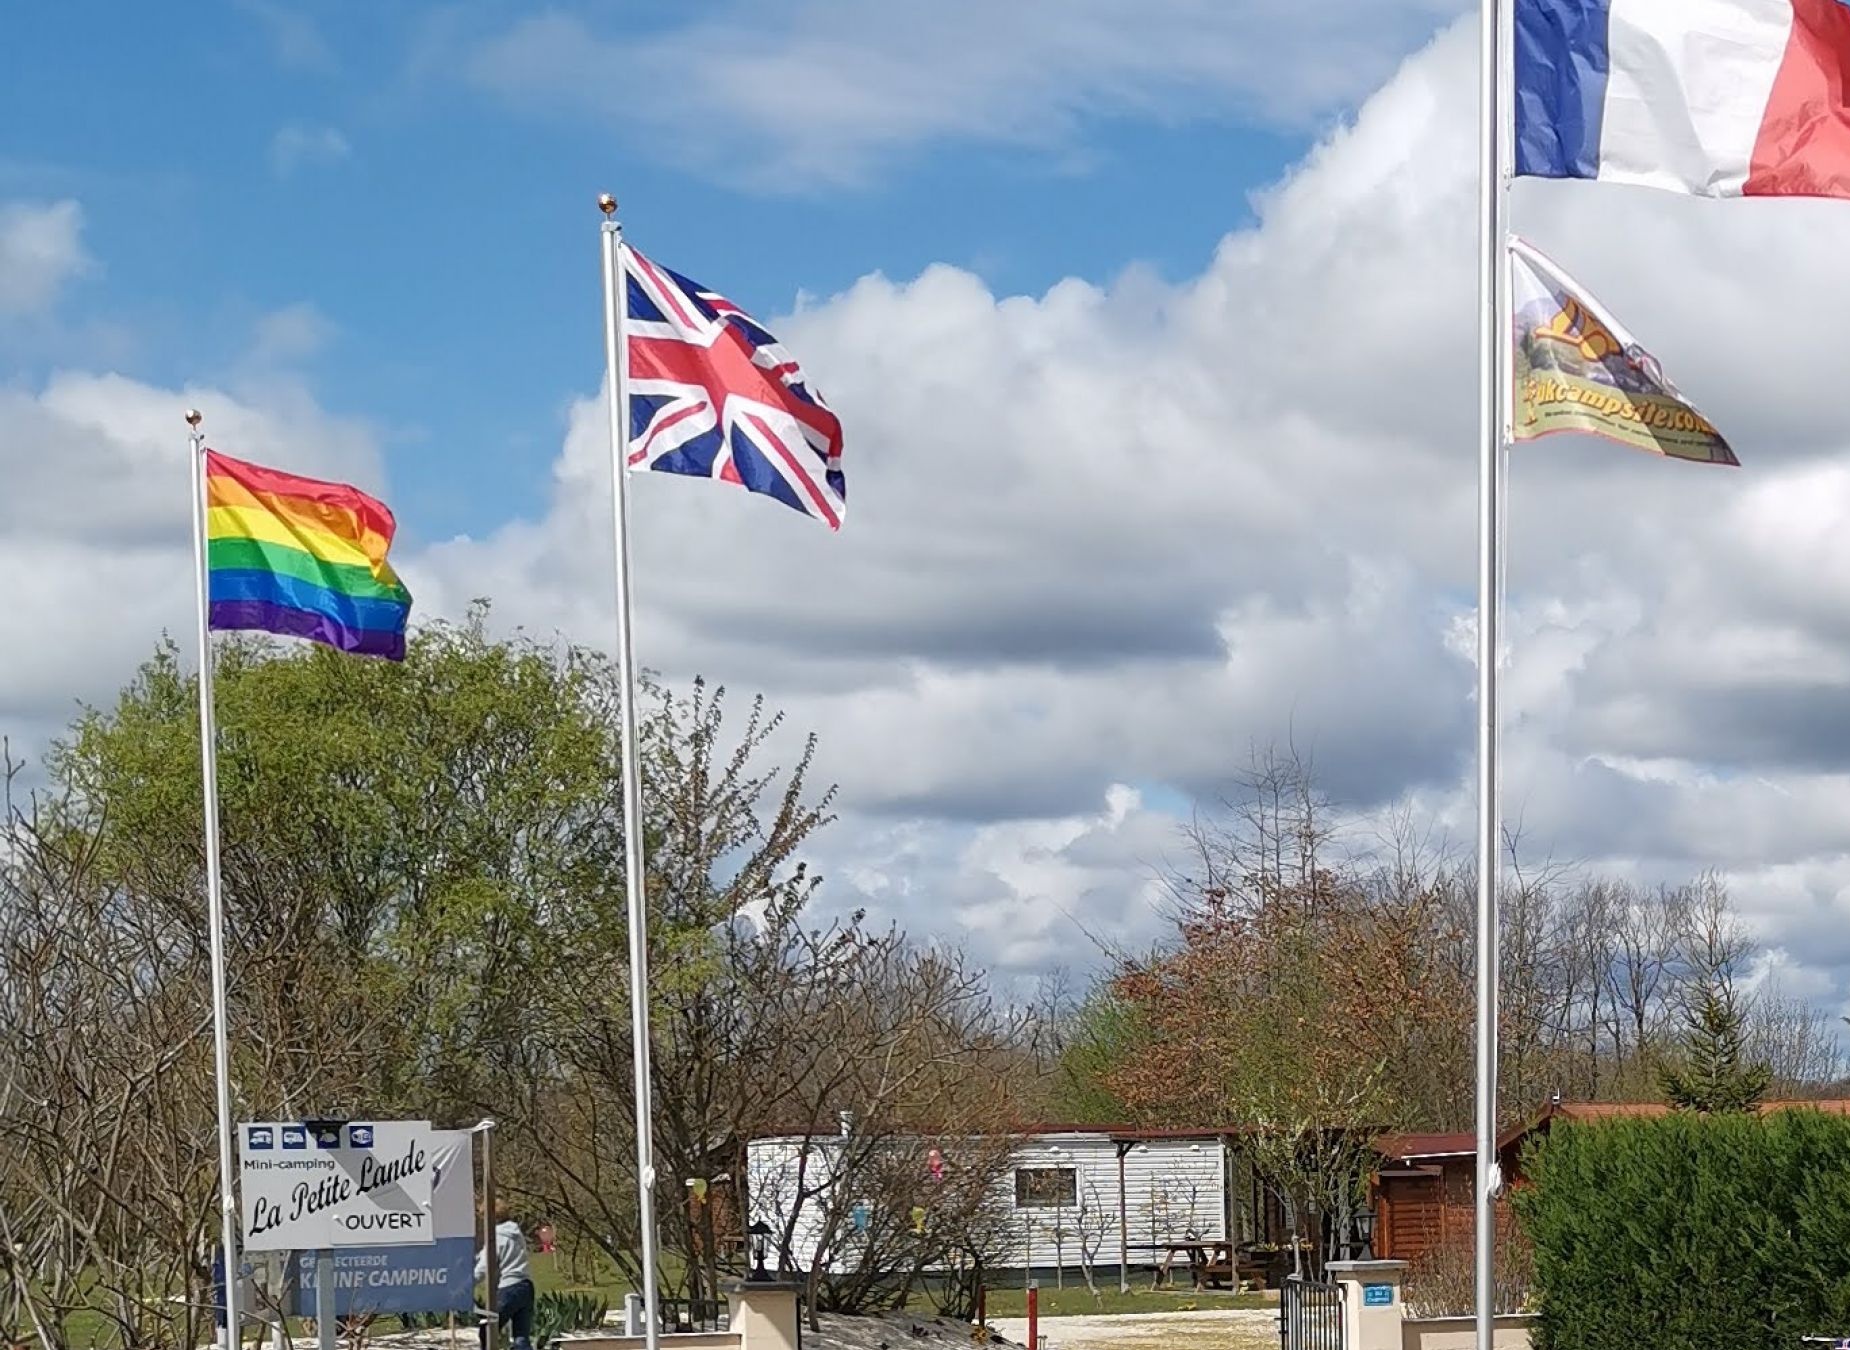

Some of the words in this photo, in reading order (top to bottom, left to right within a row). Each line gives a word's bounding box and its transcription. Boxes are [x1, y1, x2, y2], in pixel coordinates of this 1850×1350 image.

[244, 1158, 336, 1171] Mini-camping
[249, 1197, 283, 1237] La
[290, 1175, 351, 1222] Petite
[356, 1139, 426, 1195] Lande
[345, 1212, 426, 1231] OUVERT
[369, 1267, 448, 1288] CAMPING
